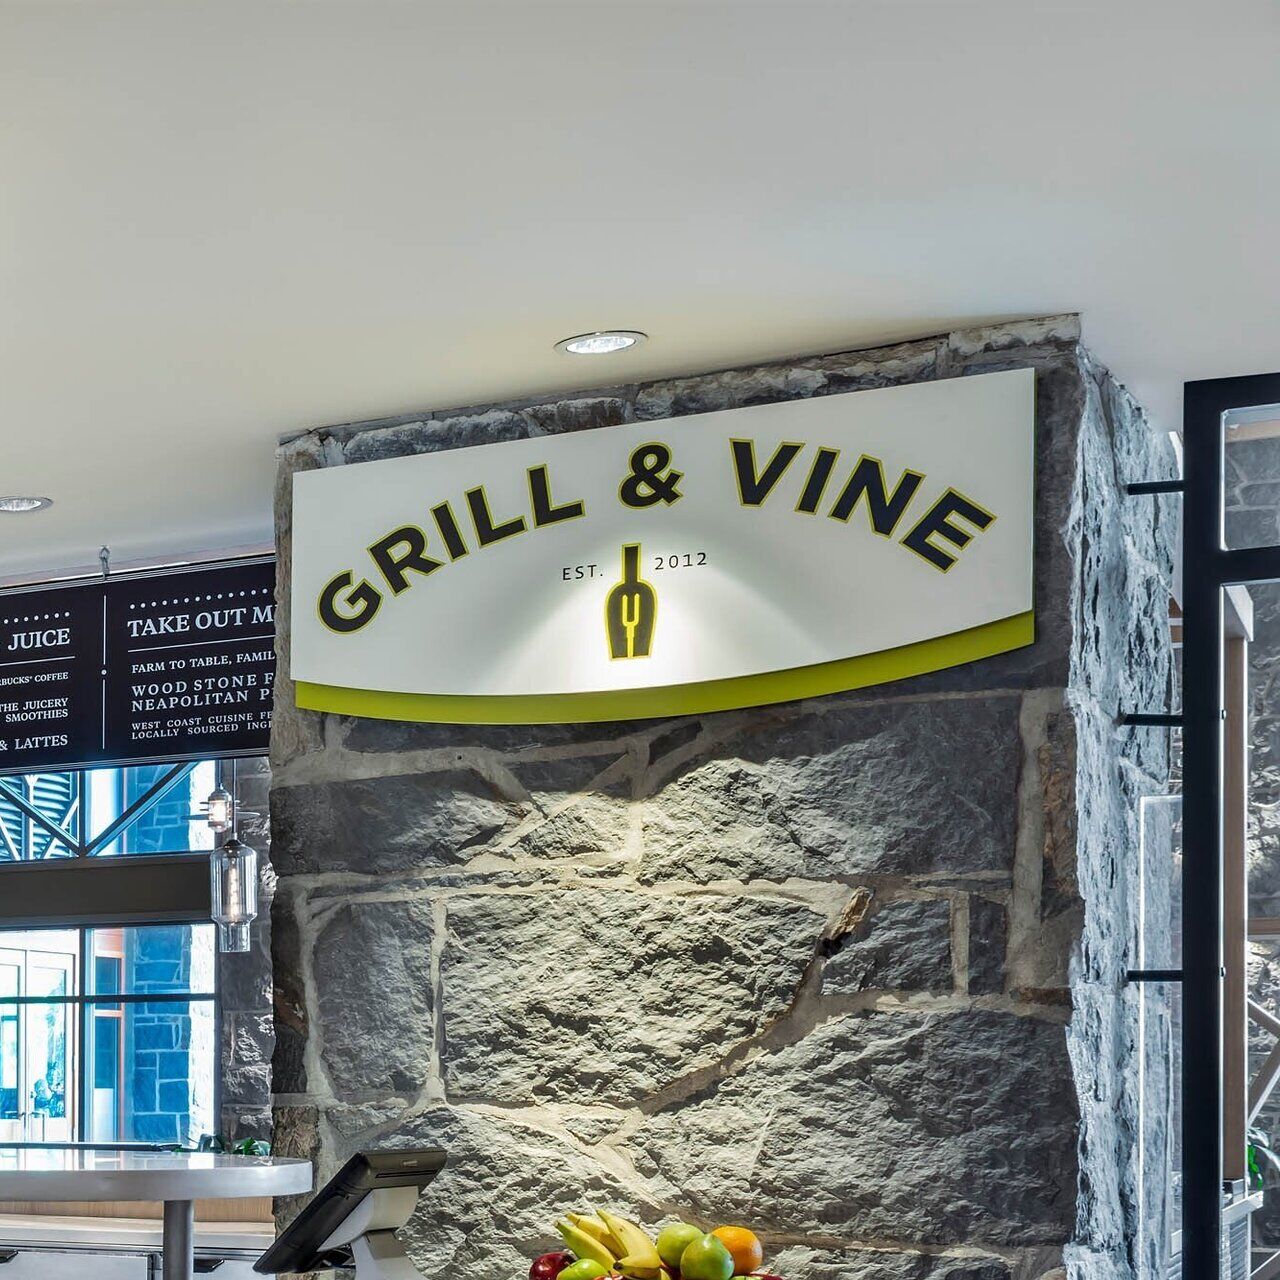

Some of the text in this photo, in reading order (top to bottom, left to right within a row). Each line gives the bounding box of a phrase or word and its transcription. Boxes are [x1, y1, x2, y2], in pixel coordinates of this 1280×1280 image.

[317, 437, 998, 635] GRILL & VINE
[562, 552, 708, 581] EST. 2012
[127, 603, 278, 638] TAKE OUT M
[7, 628, 71, 651] JUICE
[131, 662, 166, 674] FARM
[168, 660, 186, 670] TO
[189, 655, 232, 668] TABLE,
[34, 671, 69, 682] COFFEE
[131, 681, 188, 698] WOOD
[193, 674, 257, 692] STONE
[23, 698, 69, 711] JUICERY
[131, 690, 249, 712] NEAPOLITAN
[5, 708, 69, 723] SMOOTHIES
[131, 721, 161, 731] WEST
[166, 717, 202, 728] COAST
[208, 712, 253, 724] CUISINE
[131, 728, 180, 740] LOCALLY
[187, 723, 239, 735] SOURCED
[14, 734, 68, 750] LATTES
